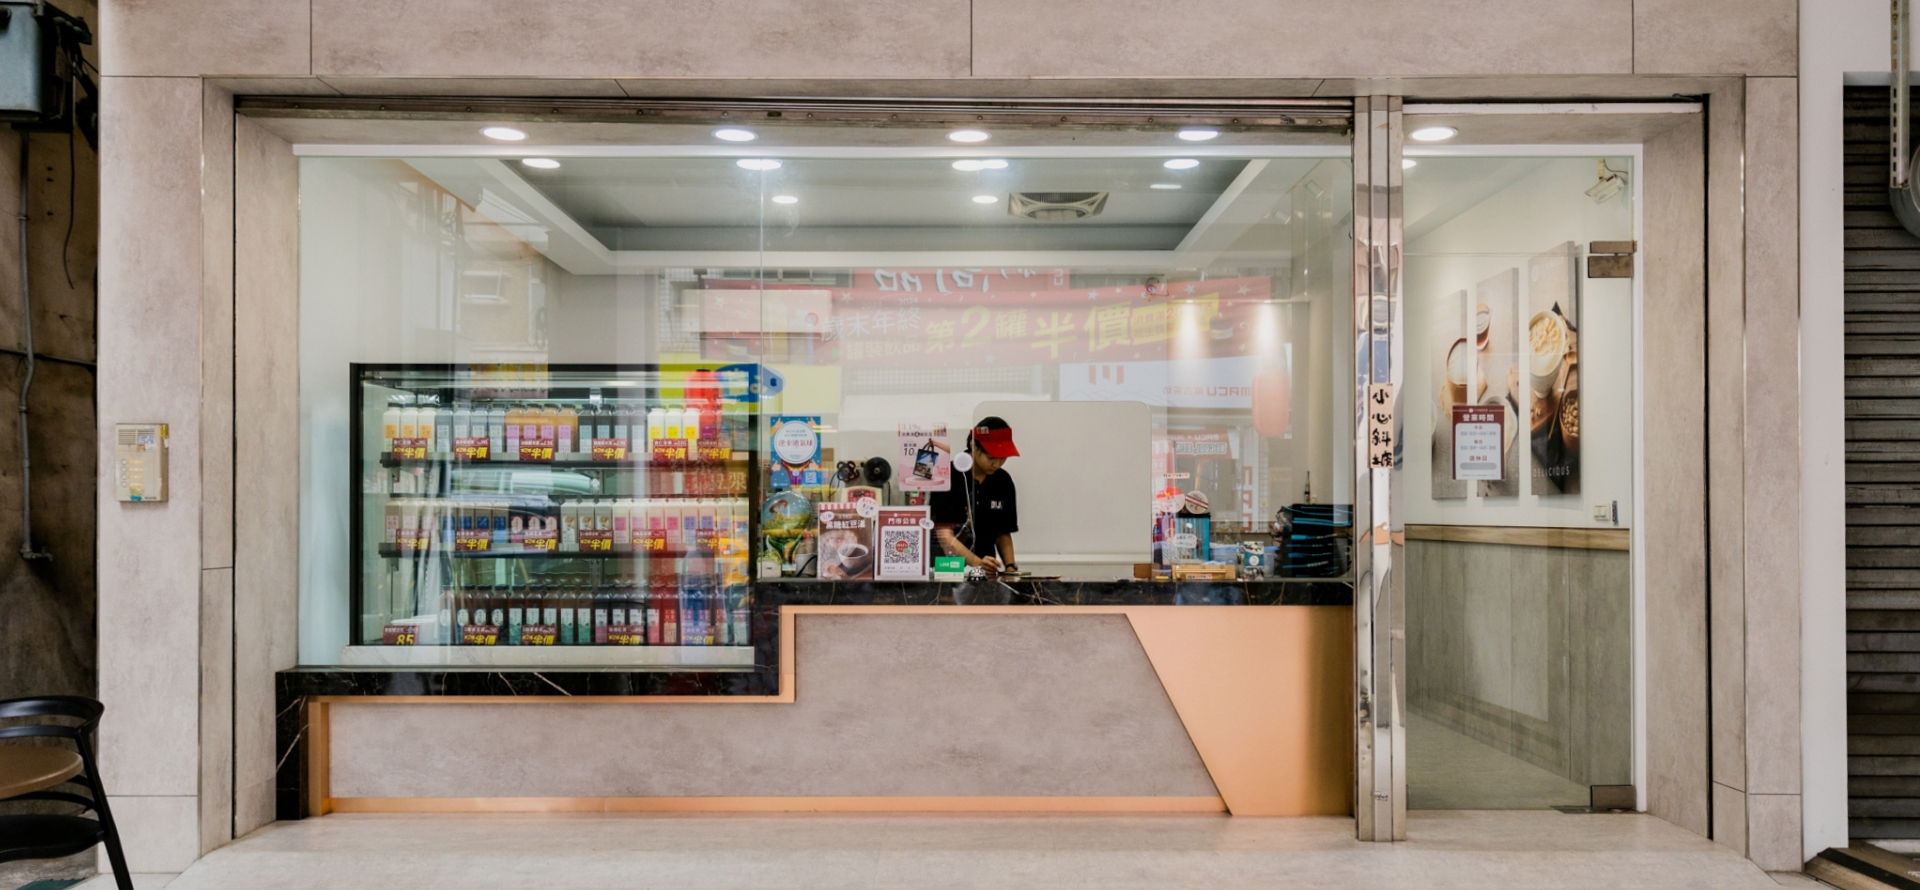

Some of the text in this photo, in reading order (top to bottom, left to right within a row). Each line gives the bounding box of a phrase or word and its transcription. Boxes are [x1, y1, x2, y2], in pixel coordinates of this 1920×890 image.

[820, 306, 922, 342] 歲末年終
[1462, 413, 1495, 422] 營業時間
[1532, 466, 1570, 478] DELICIOUS
[396, 634, 414, 646] 85
